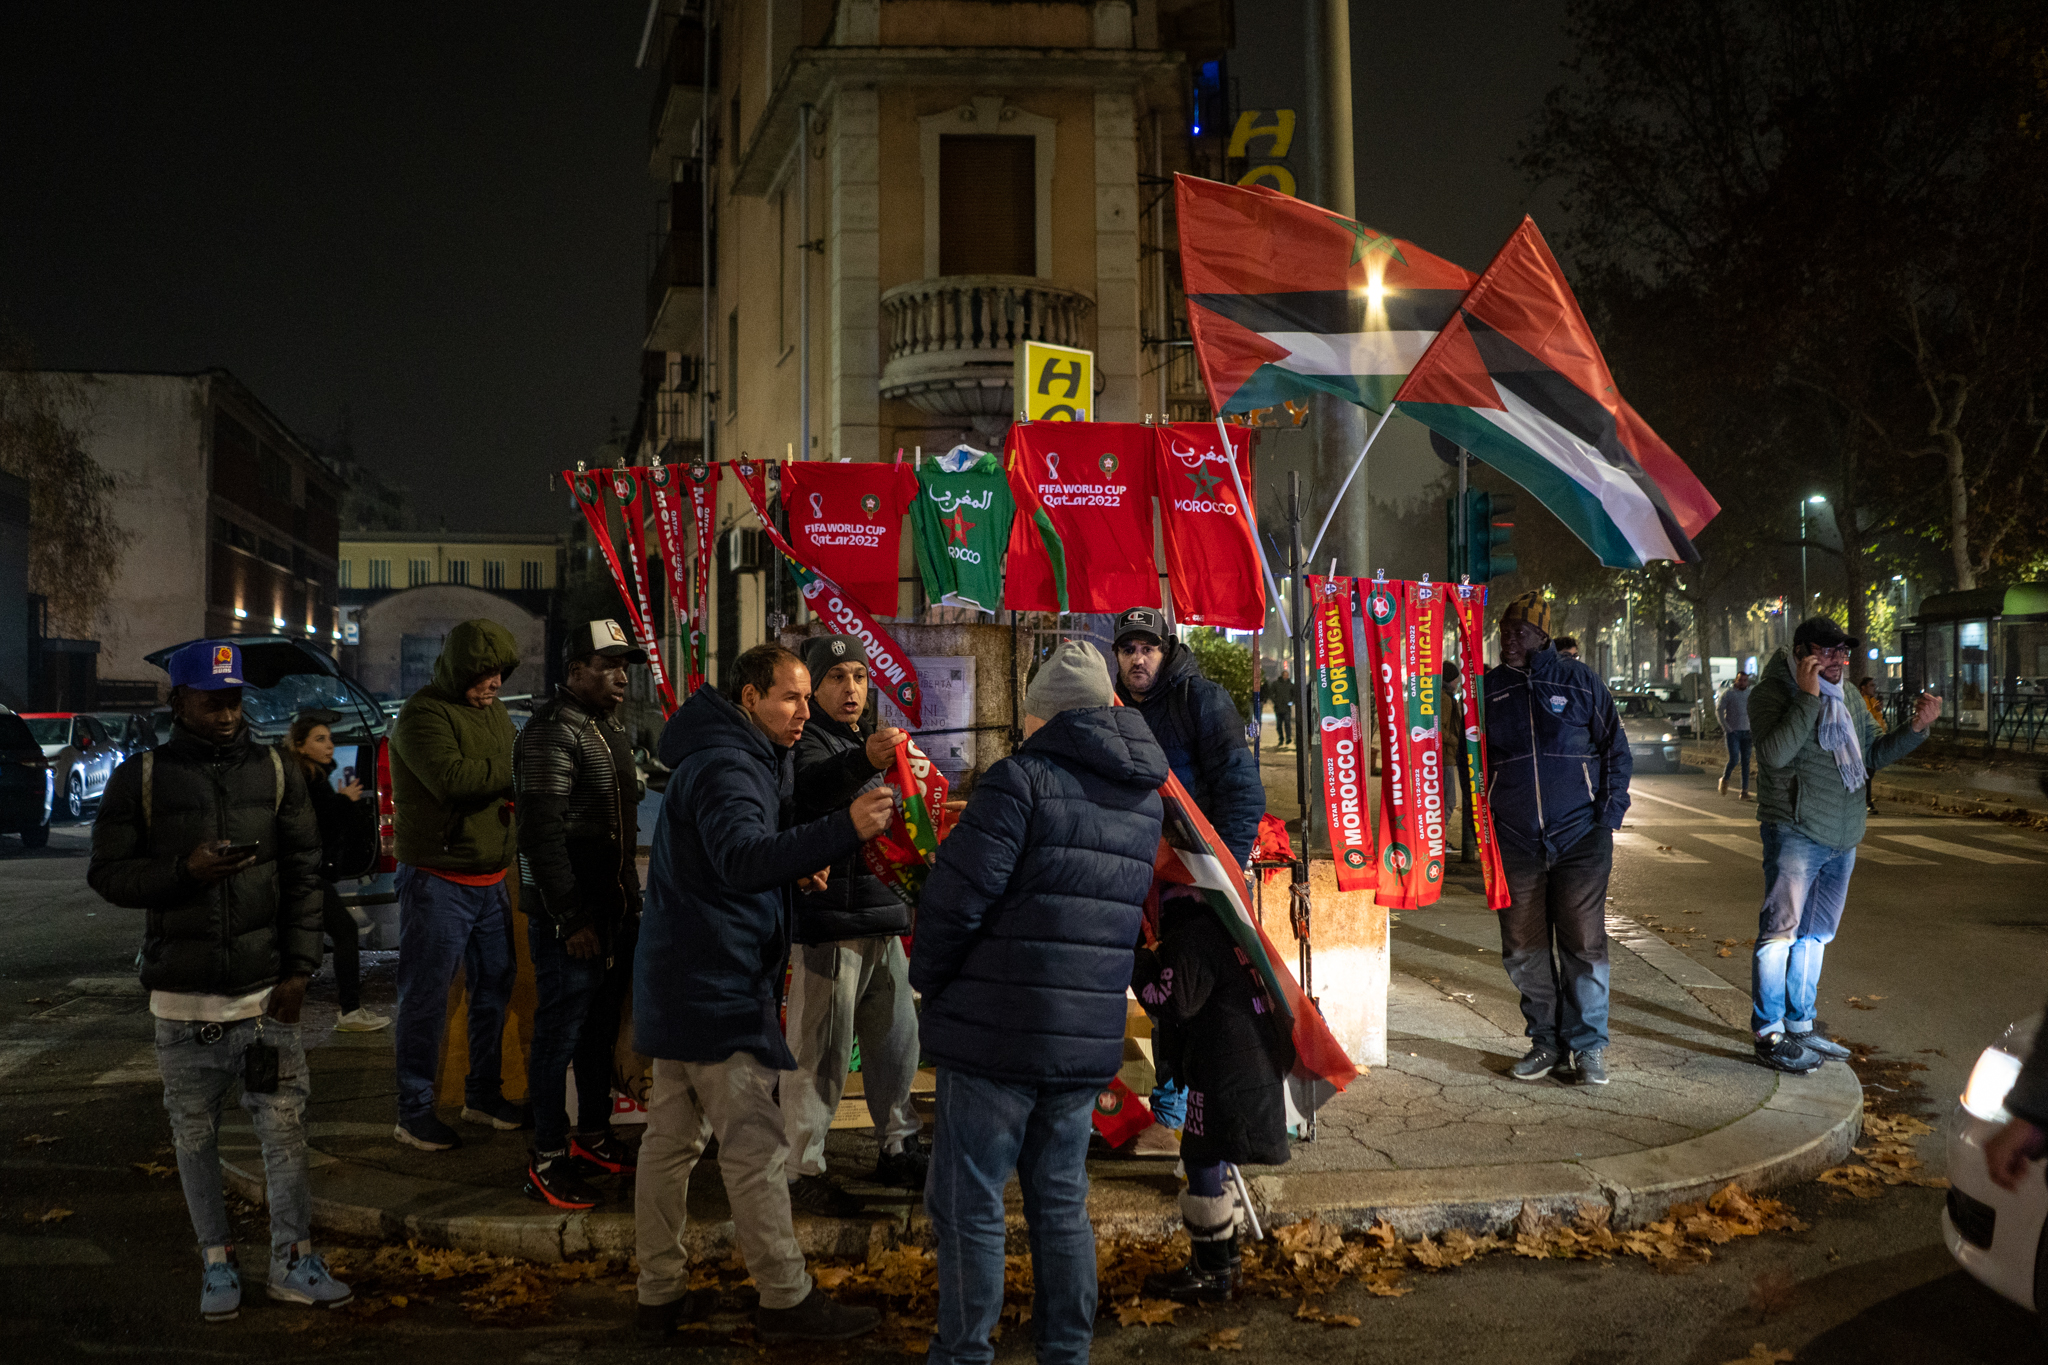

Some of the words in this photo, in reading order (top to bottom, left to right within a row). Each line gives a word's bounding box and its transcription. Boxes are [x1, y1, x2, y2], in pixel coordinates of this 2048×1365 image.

[929, 483, 993, 512] المغرب
[1038, 484, 1063, 494] FIFA
[1063, 484, 1103, 494] WORLD
[1104, 485, 1126, 495] CUP
[1174, 498, 1237, 516] MOROCCO
[804, 524, 826, 535] FIFA
[827, 523, 865, 535] WORLD
[865, 525, 887, 535] CUP
[827, 597, 907, 685] MOROCCO
[1325, 604, 1350, 706] PORTUGAL
[1418, 610, 1434, 716] PORTUGAL
[1327, 757, 1336, 797] 10-12-2022
[1336, 739, 1363, 846] MOROCCO
[1414, 768, 1422, 809] 10-12-2022
[1478, 771, 1486, 798] QATAR
[1331, 802, 1340, 828] QATAR
[1421, 750, 1443, 858] MOROCCO
[1481, 803, 1490, 844] 10-12-2022
